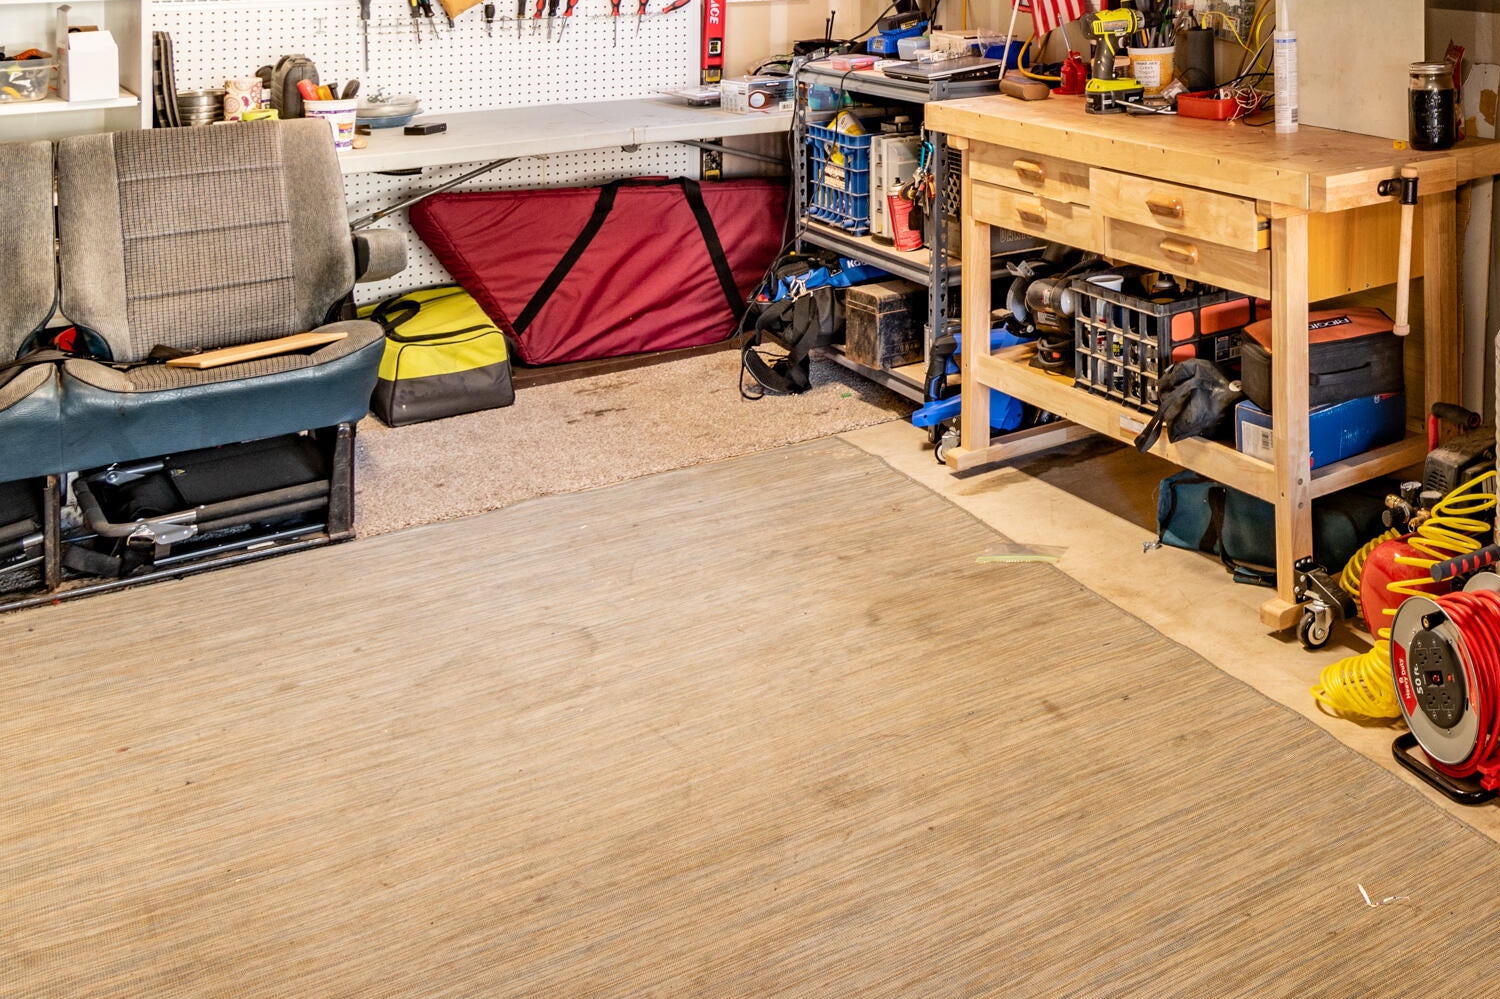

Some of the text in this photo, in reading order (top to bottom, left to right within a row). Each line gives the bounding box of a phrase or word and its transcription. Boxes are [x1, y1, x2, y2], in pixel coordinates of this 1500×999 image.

[709, 0, 721, 25] ACE
[1399, 658, 1411, 699] Heavy Duty
[1414, 677, 1424, 695] 50
